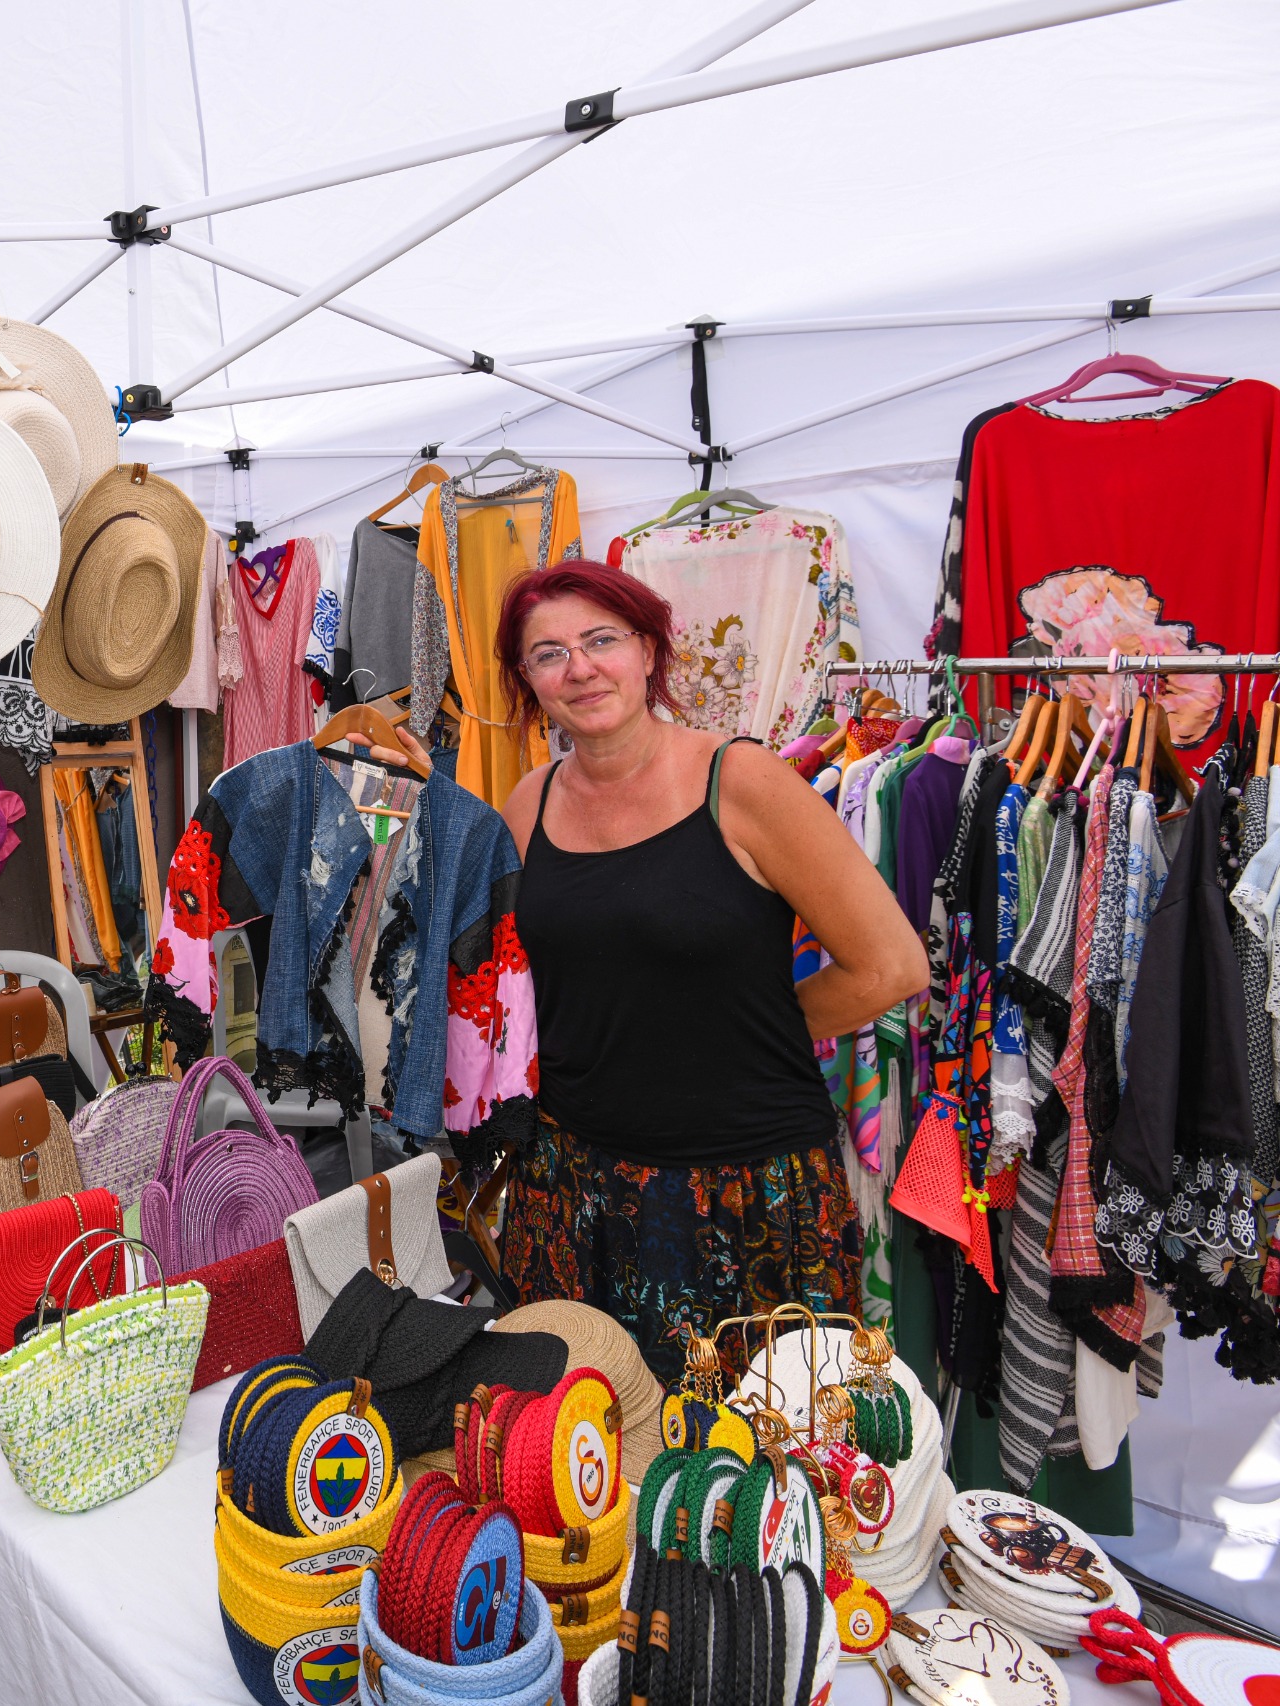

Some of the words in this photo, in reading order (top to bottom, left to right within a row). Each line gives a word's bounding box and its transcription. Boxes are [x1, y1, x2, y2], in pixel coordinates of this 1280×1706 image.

[298, 1418, 340, 1512] FENERBAHÇE
[345, 1418, 374, 1443] SPOR
[364, 1443, 383, 1508] KULÜBÜ
[328, 1549, 365, 1564] SPOR
[277, 1631, 333, 1695] FENERBAHÇE
[339, 1629, 358, 1641] SP
